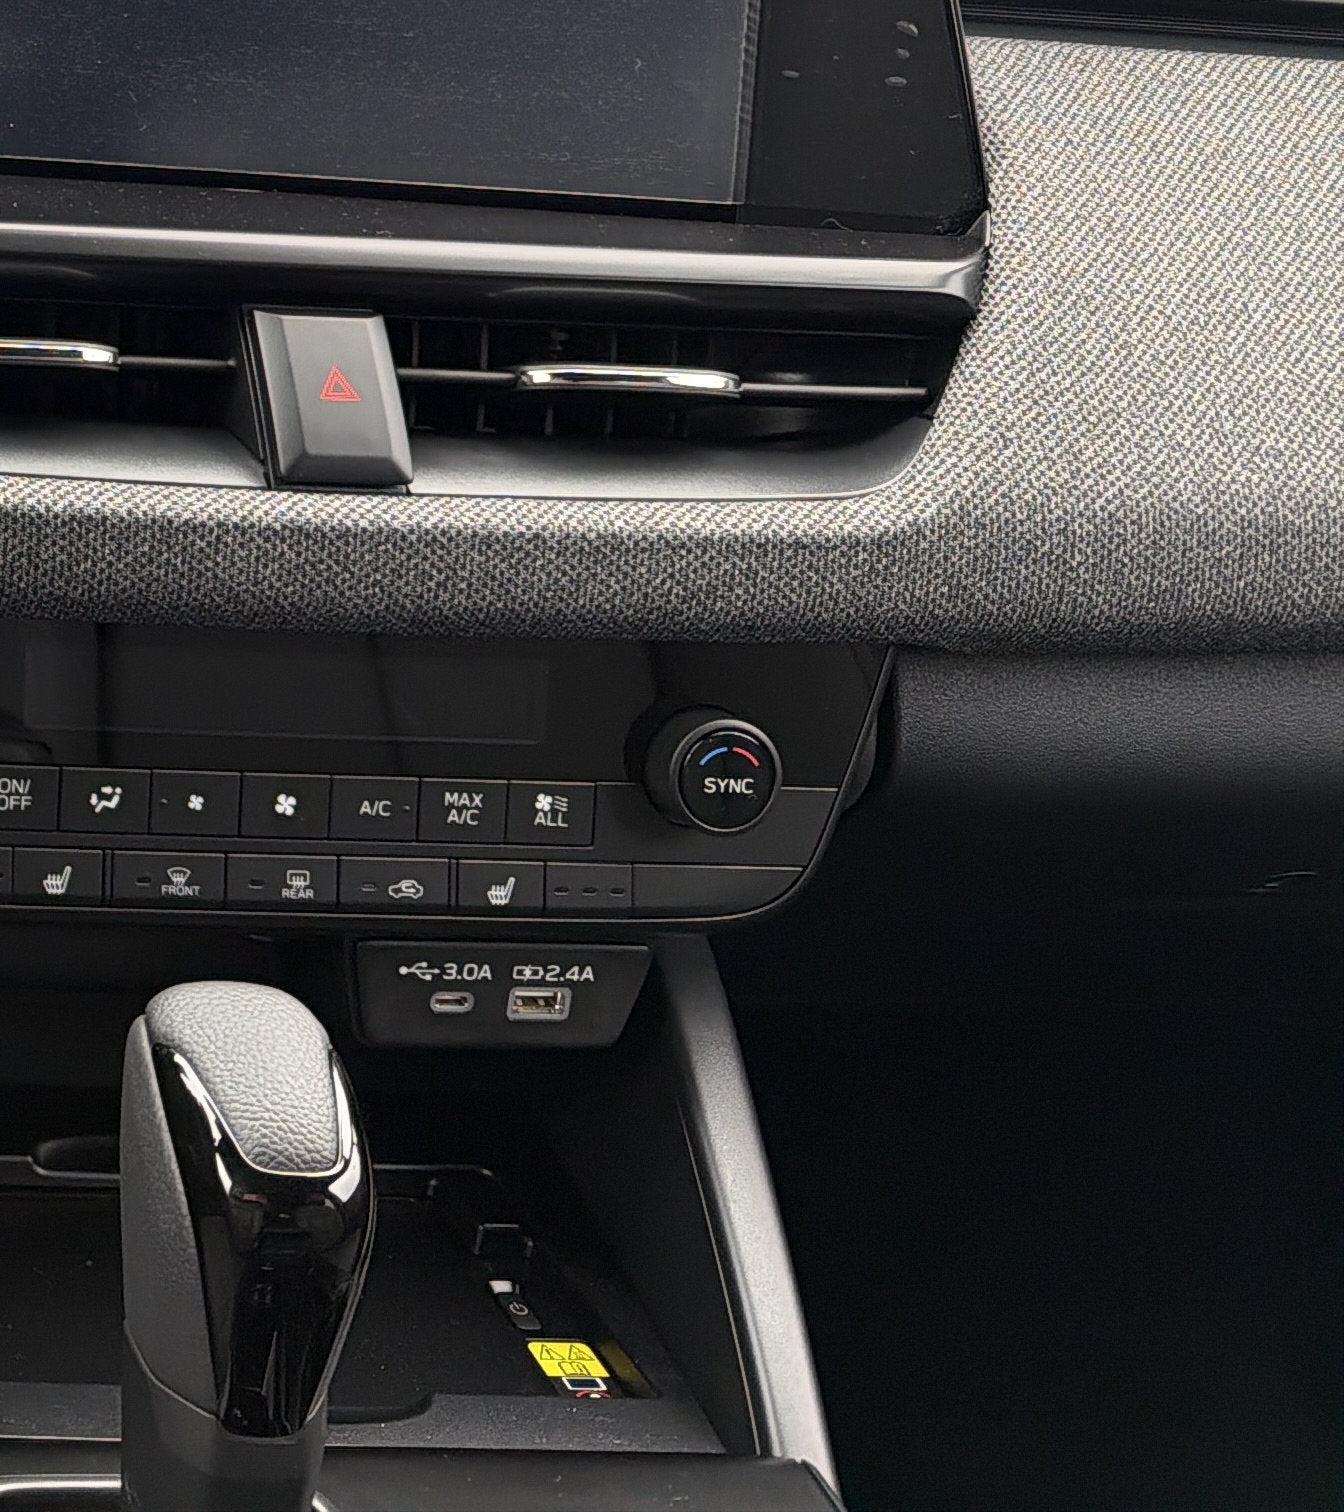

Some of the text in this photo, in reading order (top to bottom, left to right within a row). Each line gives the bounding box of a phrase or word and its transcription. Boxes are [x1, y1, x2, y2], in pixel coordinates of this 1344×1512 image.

[704, 777, 755, 795] SYNC
[359, 800, 392, 817] A/C
[444, 792, 483, 808] MAX
[446, 808, 479, 825] A/C
[533, 811, 568, 827] ALL
[162, 885, 200, 896] FRONT
[281, 888, 314, 899] REAR
[442, 963, 492, 981] 3.0A
[545, 965, 595, 982] 2.4A
